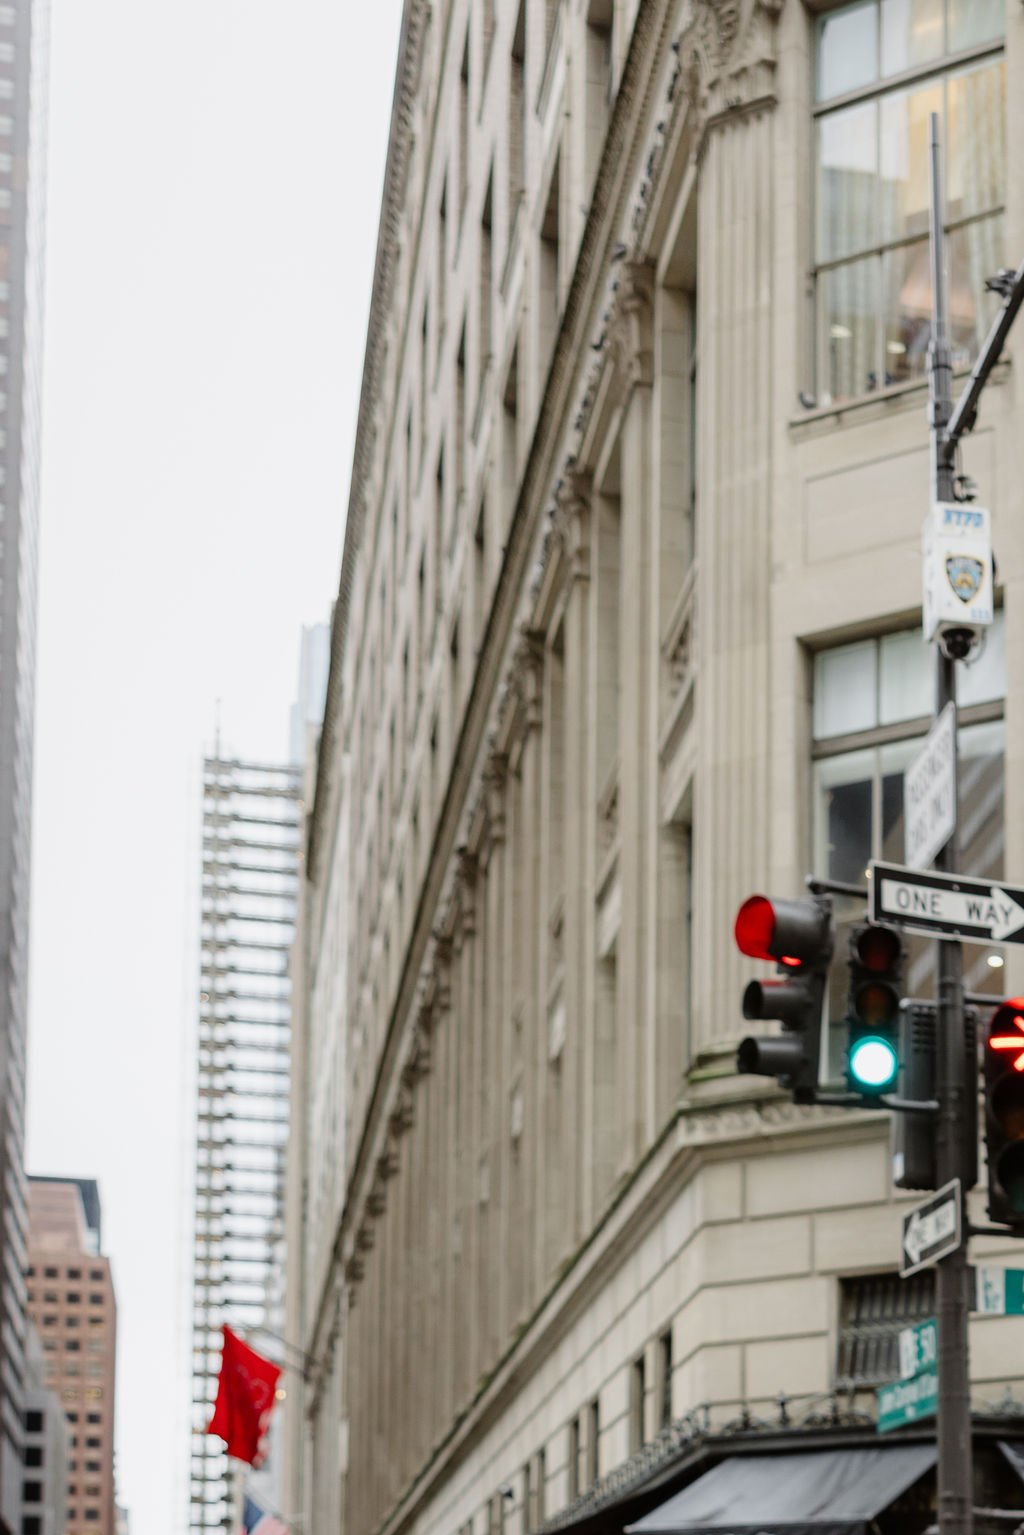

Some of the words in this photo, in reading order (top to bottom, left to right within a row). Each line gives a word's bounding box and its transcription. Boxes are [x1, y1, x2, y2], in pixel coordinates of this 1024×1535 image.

[943, 507, 984, 529] NYPD
[896, 886, 942, 916] ONE
[966, 899, 1013, 926] WAY
